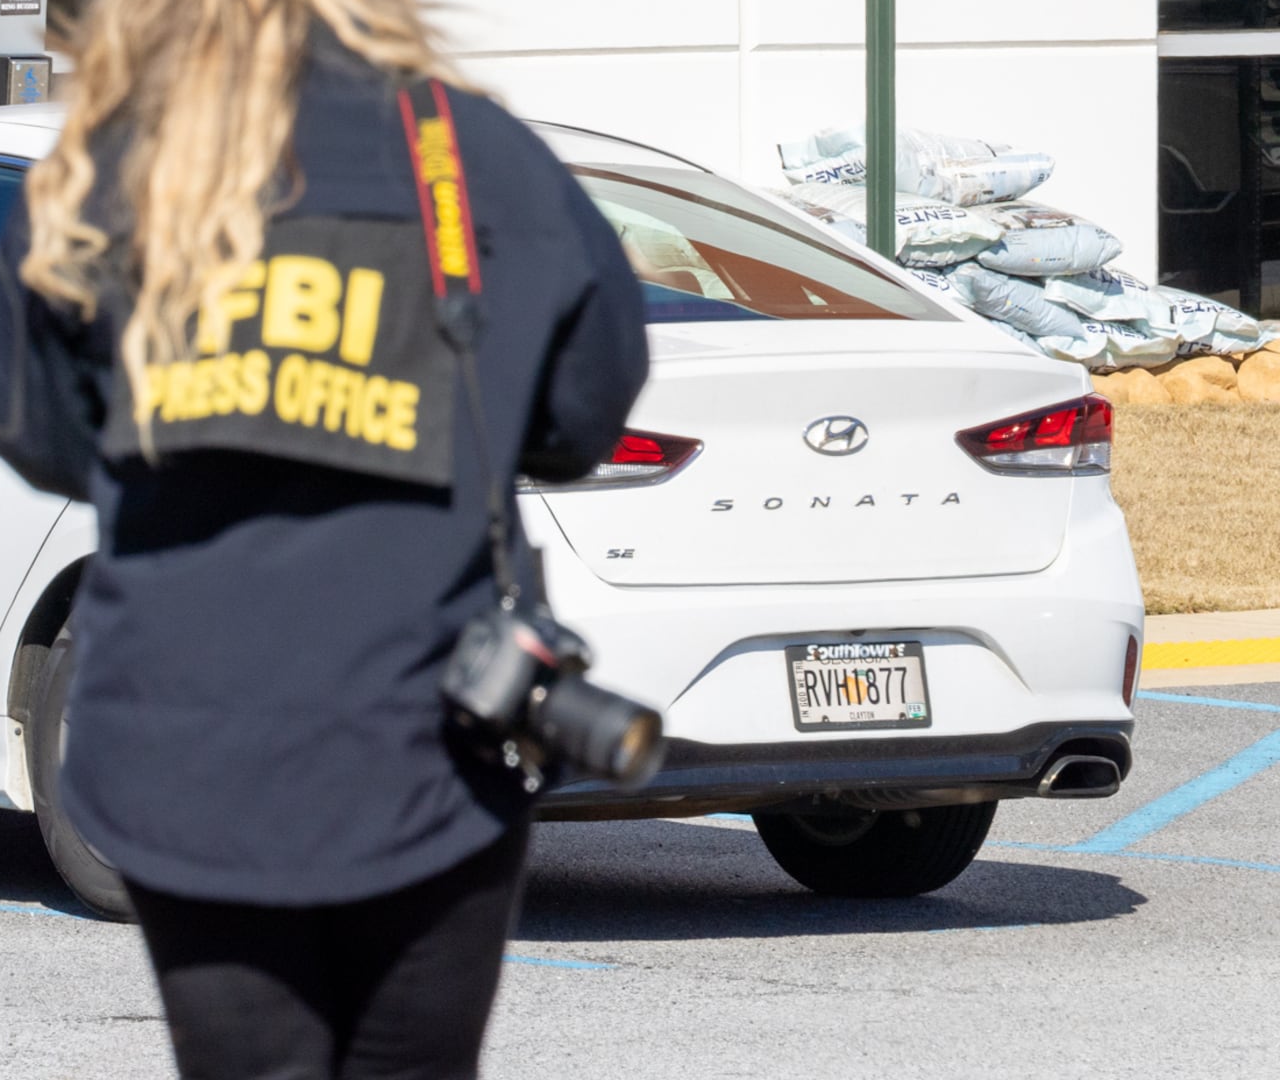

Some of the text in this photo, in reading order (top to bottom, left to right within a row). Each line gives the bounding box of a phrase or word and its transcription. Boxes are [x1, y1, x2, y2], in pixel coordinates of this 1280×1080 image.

[805, 160, 867, 183] CENTRA
[197, 254, 385, 367] FBI
[138, 349, 421, 452] PRESS OFFICE
[710, 491, 964, 512] SONATA
[606, 548, 635, 559] SE
[804, 667, 907, 707] RVH1877
[850, 711, 875, 721] CLAYTON
[909, 704, 922, 712] FEB
